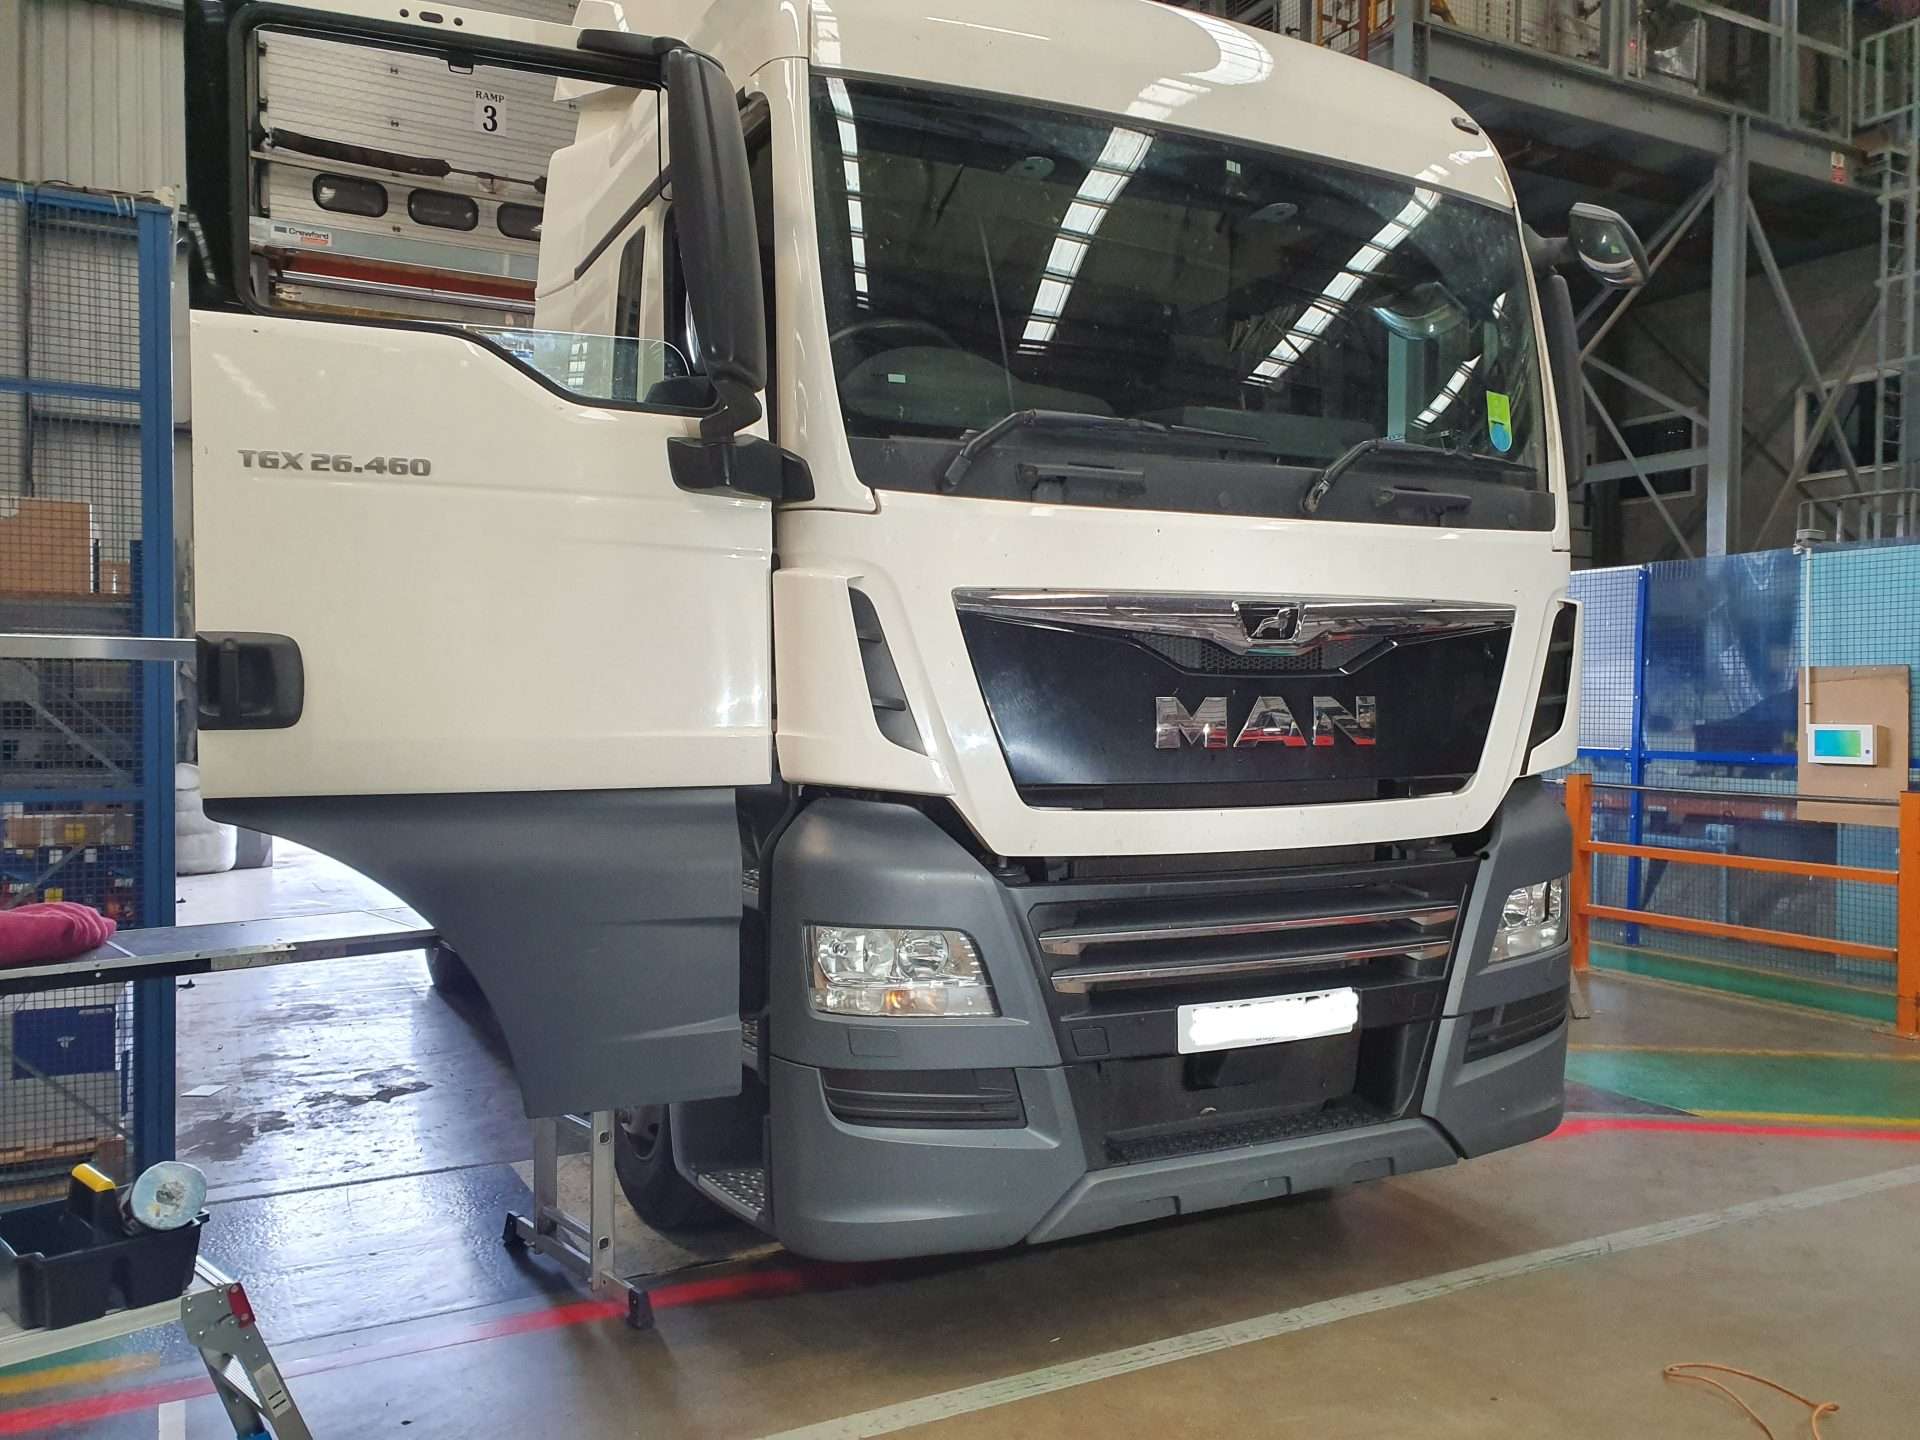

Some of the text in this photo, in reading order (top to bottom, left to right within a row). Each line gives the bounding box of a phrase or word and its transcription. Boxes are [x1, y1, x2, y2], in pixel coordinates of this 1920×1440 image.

[475, 90, 505, 104] RAMP
[482, 104, 498, 132] 3
[238, 449, 432, 476] TGX 26.460
[1155, 696, 1377, 749] MAN
